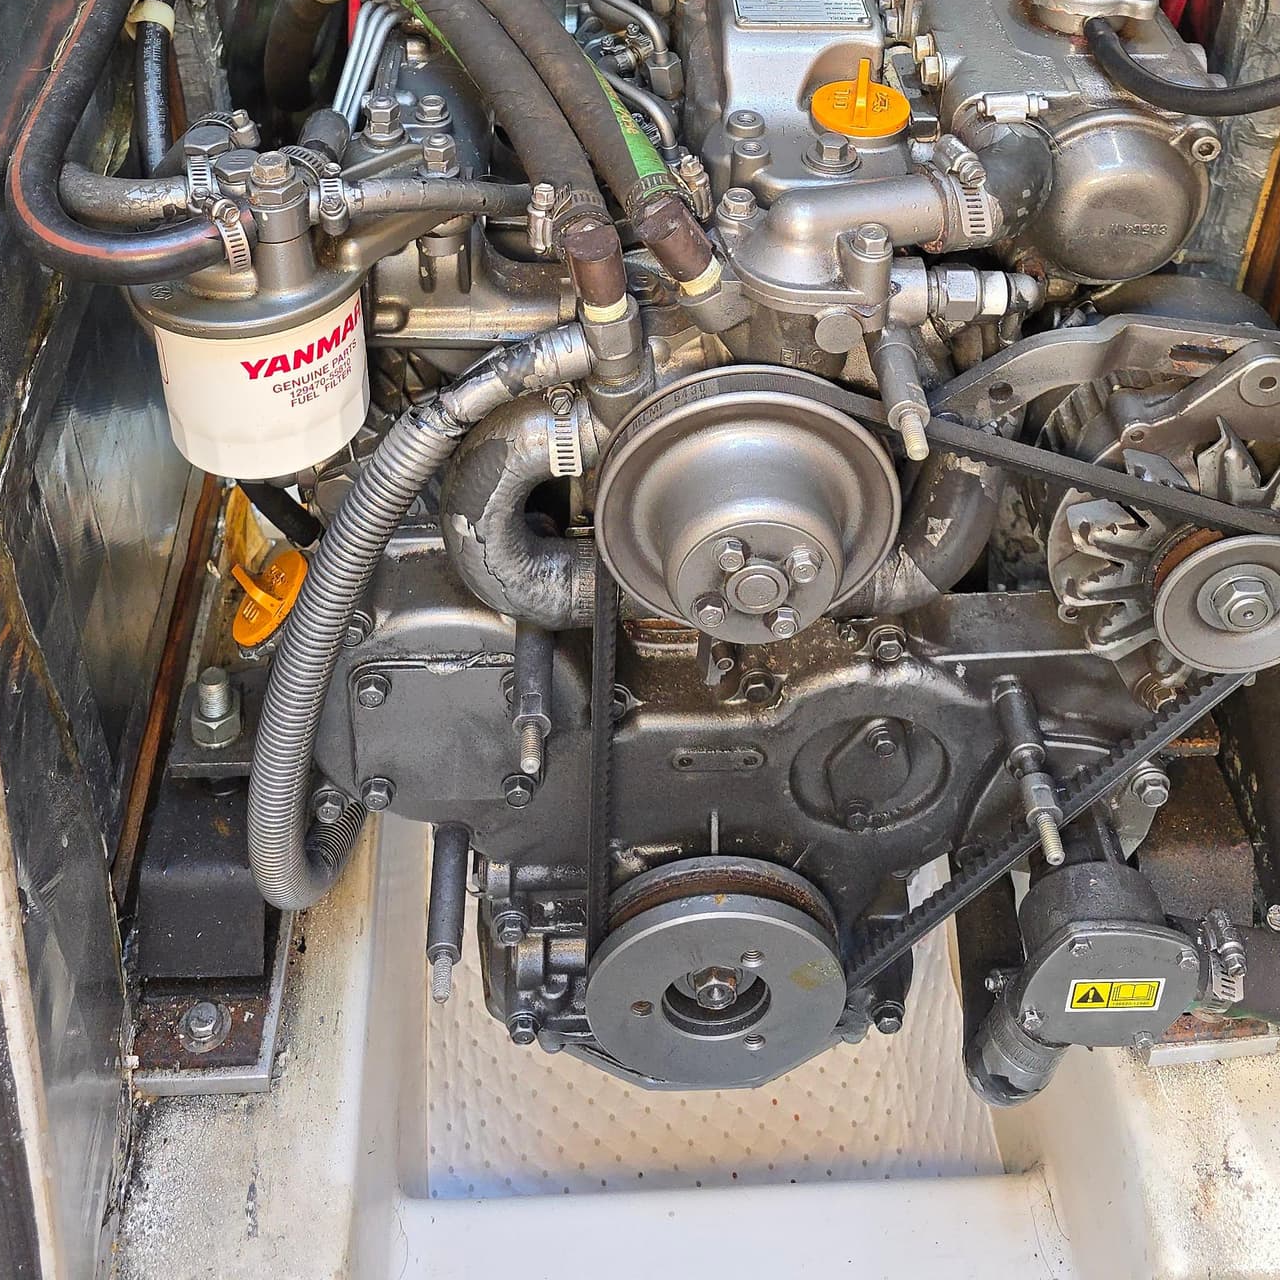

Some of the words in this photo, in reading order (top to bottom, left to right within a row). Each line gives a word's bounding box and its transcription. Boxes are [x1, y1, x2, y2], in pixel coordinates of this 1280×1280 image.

[272, 363, 330, 394] GENUINE
[331, 338, 358, 369] PARTS
[290, 391, 321, 407] FUEL
[324, 366, 353, 393] FILTER
